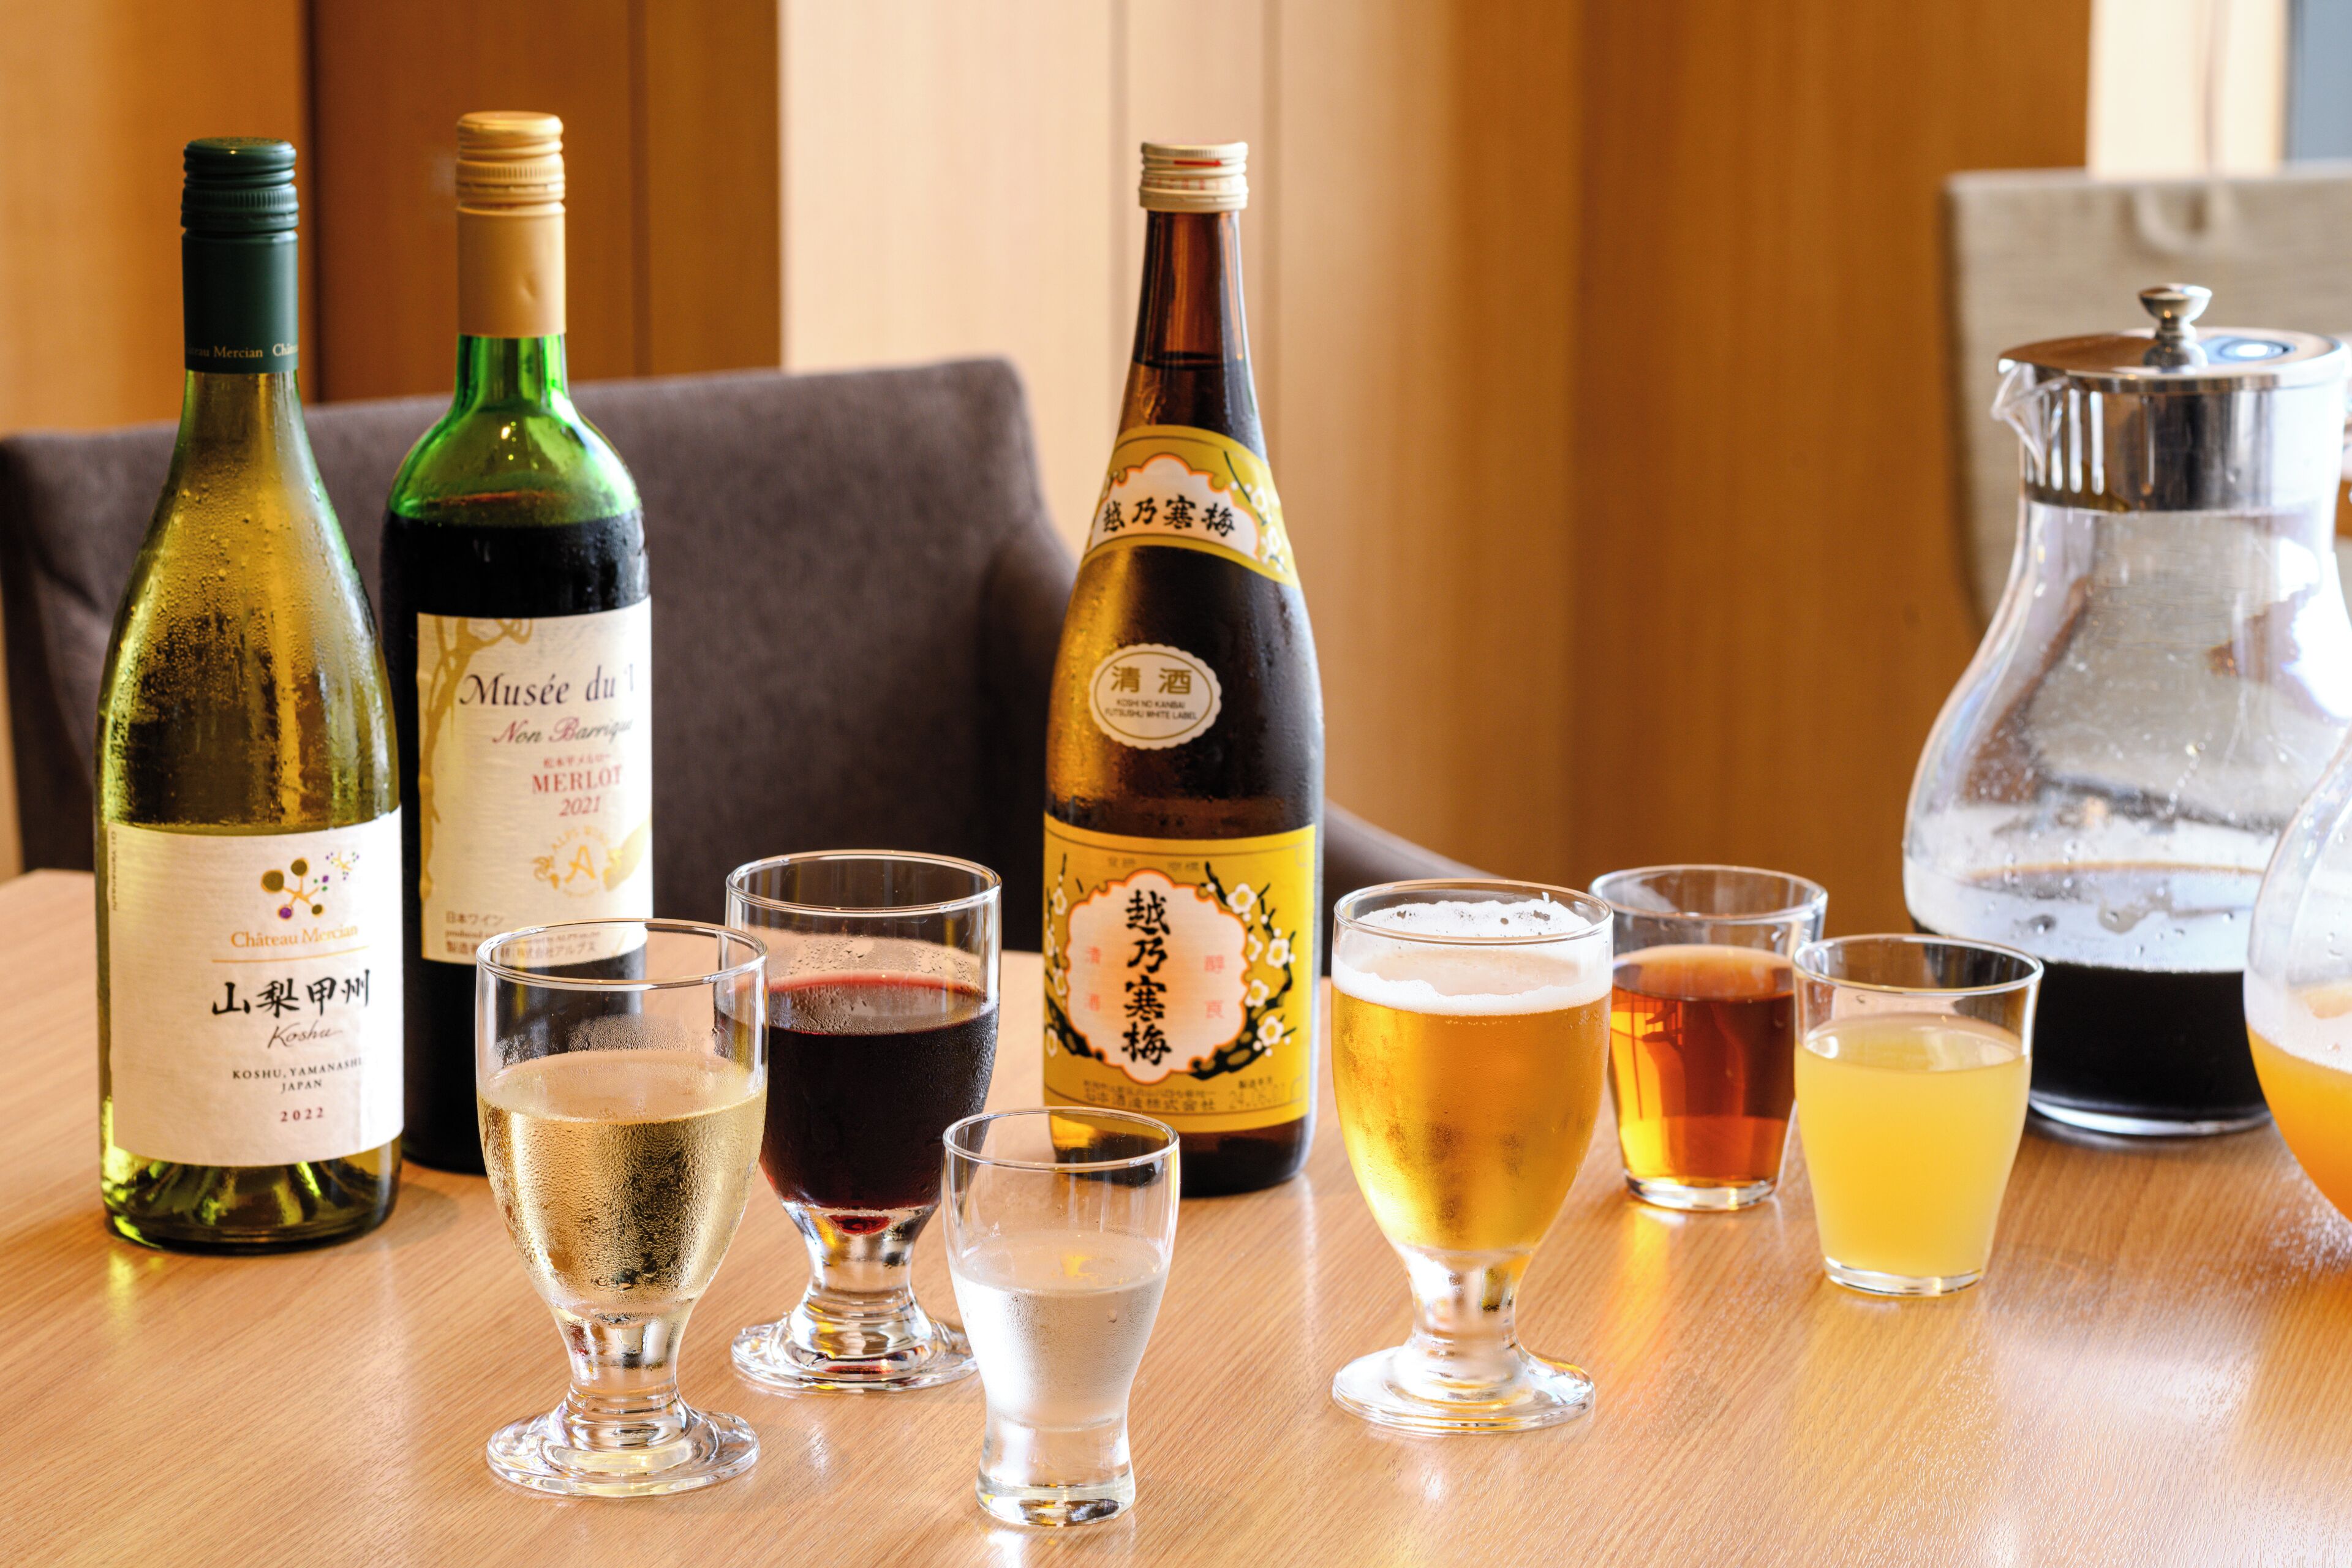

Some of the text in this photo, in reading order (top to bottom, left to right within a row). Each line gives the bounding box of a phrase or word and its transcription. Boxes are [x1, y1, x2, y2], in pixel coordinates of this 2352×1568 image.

[214, 345, 263, 358] Mercian
[1102, 494, 1236, 537] 越乃寒梅
[459, 673, 570, 706] Musée
[586, 665, 616, 703] du
[1110, 666, 1192, 695] 清酒
[492, 719, 541, 744] Non
[532, 764, 622, 794] MERLOT
[559, 795, 601, 817] 2021
[230, 924, 358, 948] Château Mercian
[1121, 889, 1172, 1066] 越乃寒梅
[212, 969, 370, 1018] 山梨甲州
[267, 1020, 343, 1049] Koshu
[233, 1057, 362, 1080] KOSHU, YAMANASHI
[280, 1079, 323, 1094] JAPAN
[280, 1107, 324, 1122] 2022
